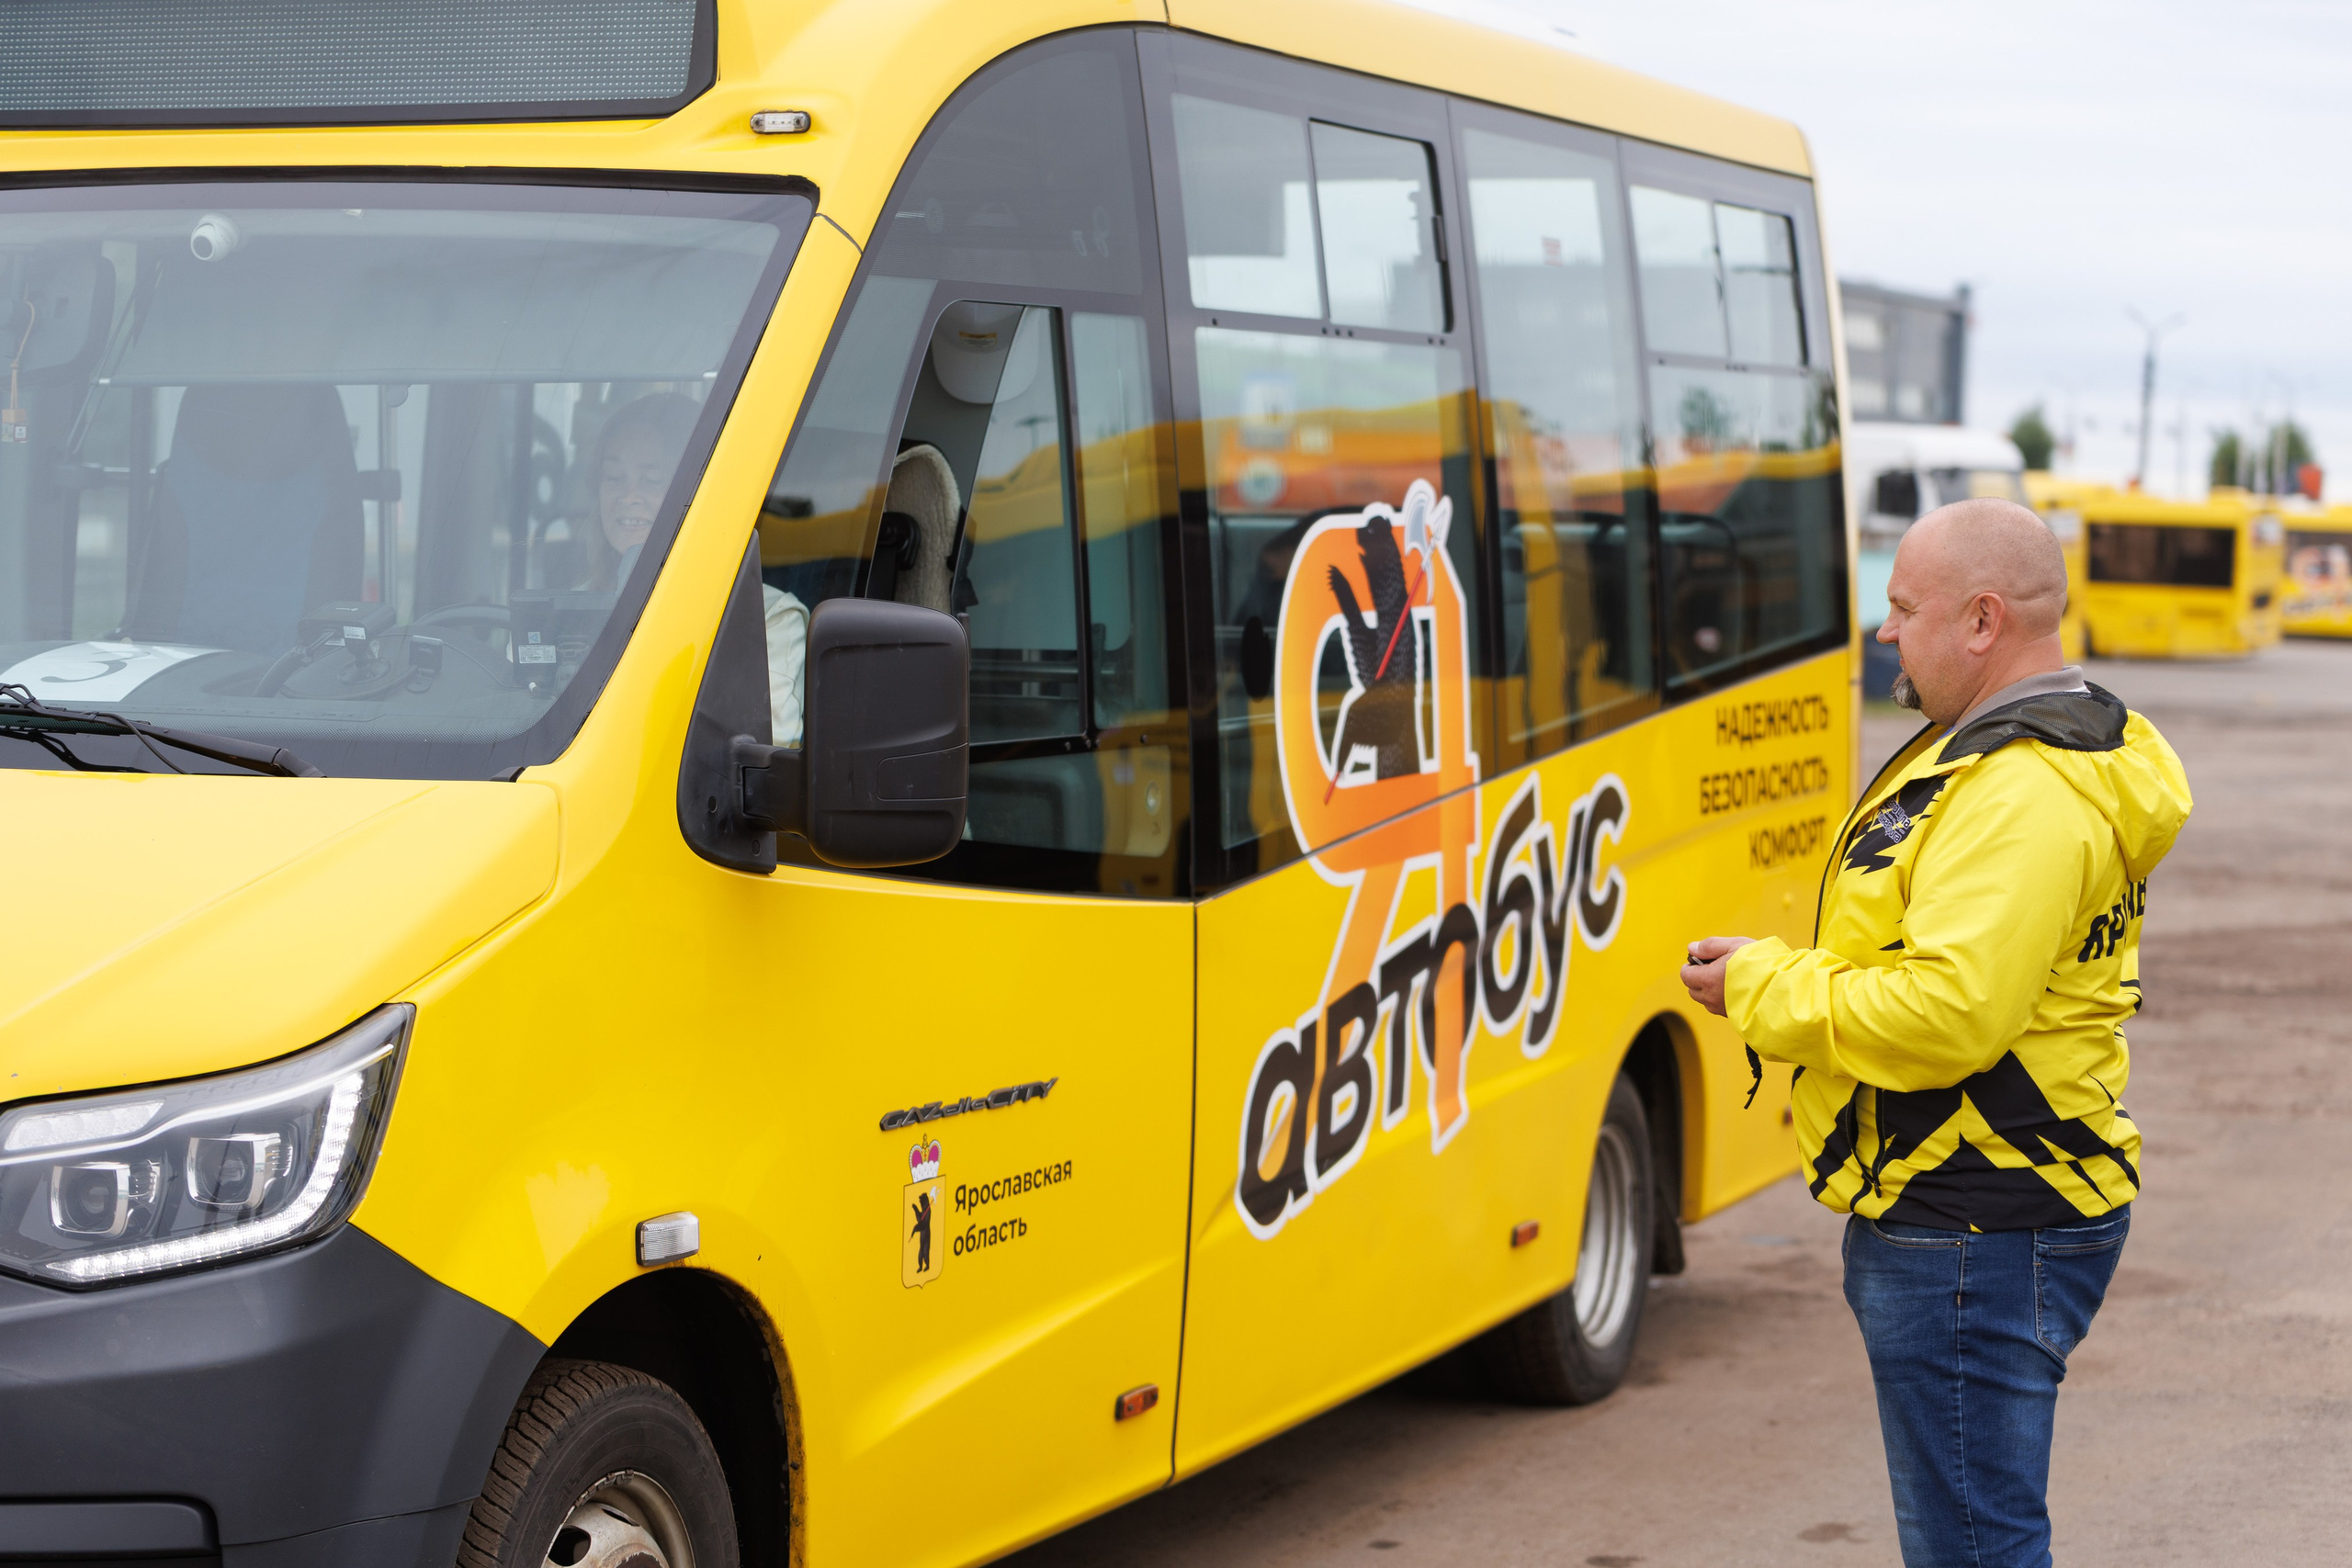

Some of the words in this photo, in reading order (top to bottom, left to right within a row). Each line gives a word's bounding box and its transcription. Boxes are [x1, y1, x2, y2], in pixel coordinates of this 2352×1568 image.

[1715, 695, 1828, 750] НАДЕЖНОСТЬ
[1701, 757, 1828, 815] БЕЗОПАСНОСТЬ
[1749, 815, 1826, 870] КОМФОРТ
[955, 1159, 1072, 1215] Ярославская
[953, 1217, 1027, 1257] область
